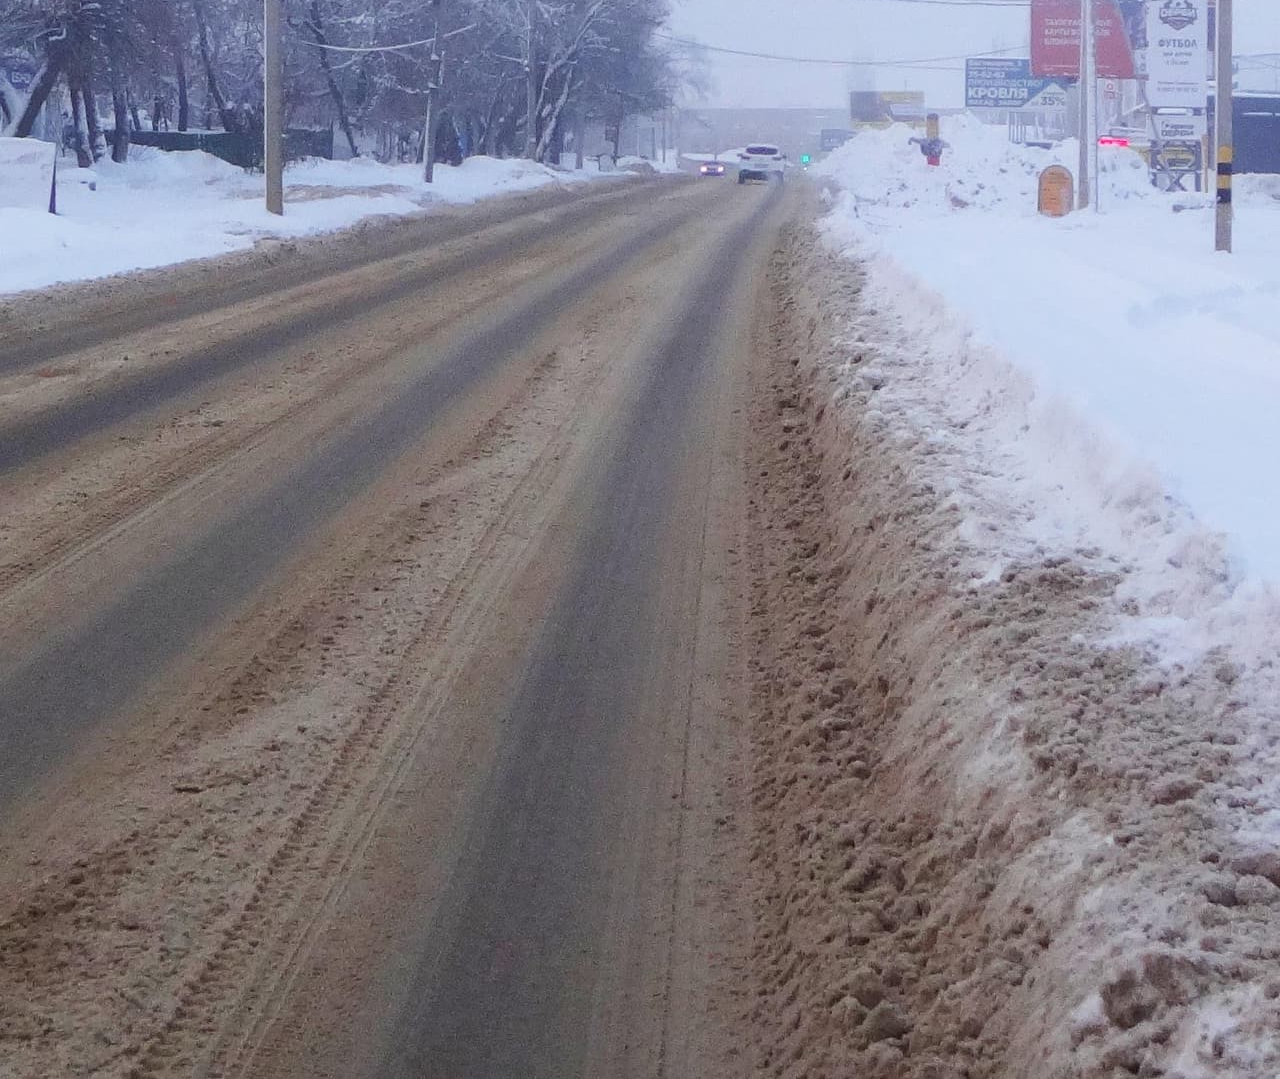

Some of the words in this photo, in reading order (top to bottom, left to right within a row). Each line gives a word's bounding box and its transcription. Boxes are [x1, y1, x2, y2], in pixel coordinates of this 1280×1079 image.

[1158, 38, 1199, 49] ФУТБОЛ
[967, 87, 1029, 99] КРОВЛЯ
[1039, 95, 1066, 107] 35%
